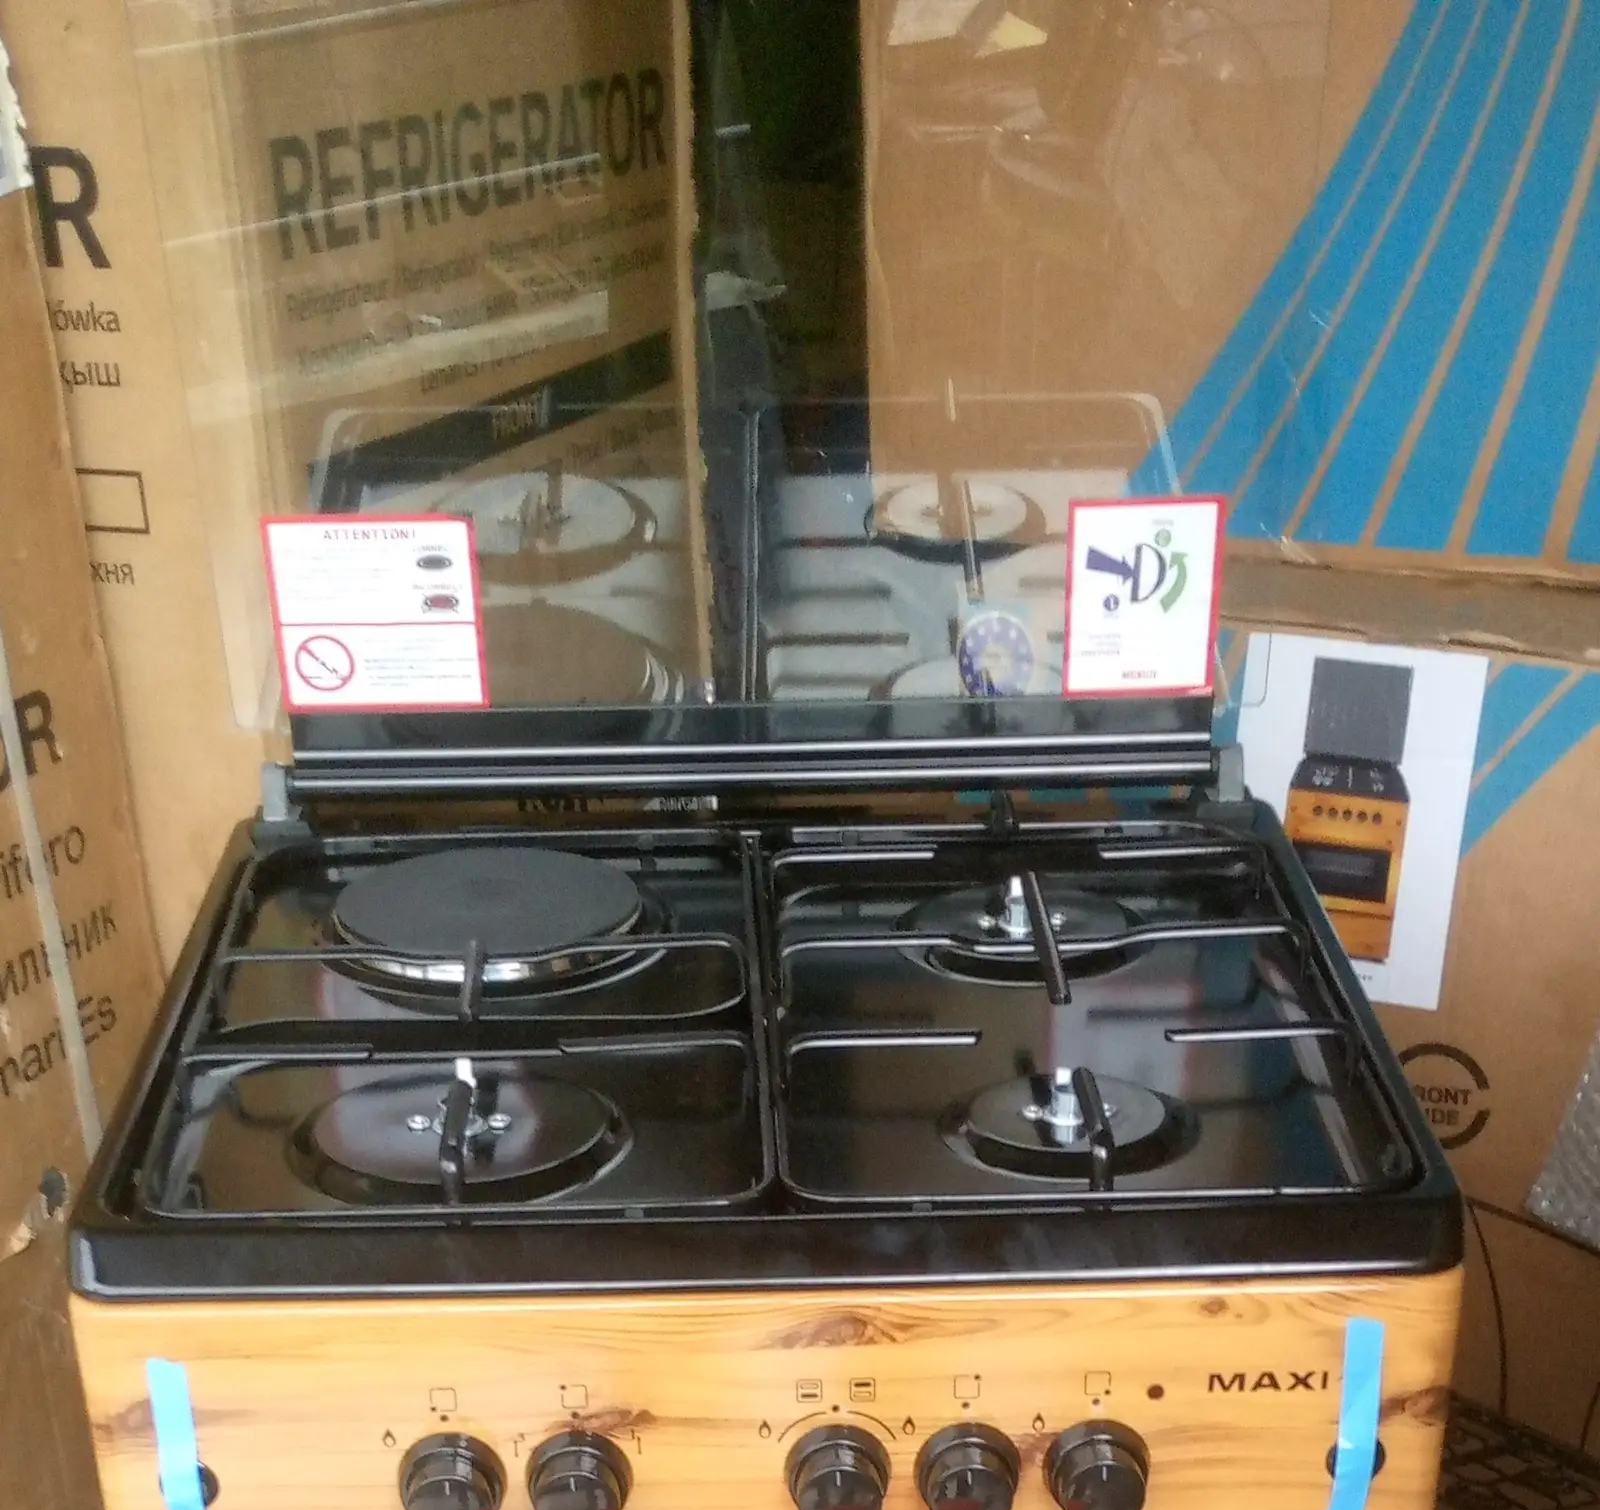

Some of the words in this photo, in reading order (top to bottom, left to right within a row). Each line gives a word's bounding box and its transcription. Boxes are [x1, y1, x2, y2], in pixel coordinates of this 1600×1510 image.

[268, 67, 671, 261] REFRIGERATOR
[46, 299, 121, 332] ówka
[1413, 1084, 1473, 1106] RONT
[1424, 1106, 1461, 1126] IDE
[1206, 1370, 1329, 1393] MAXI
